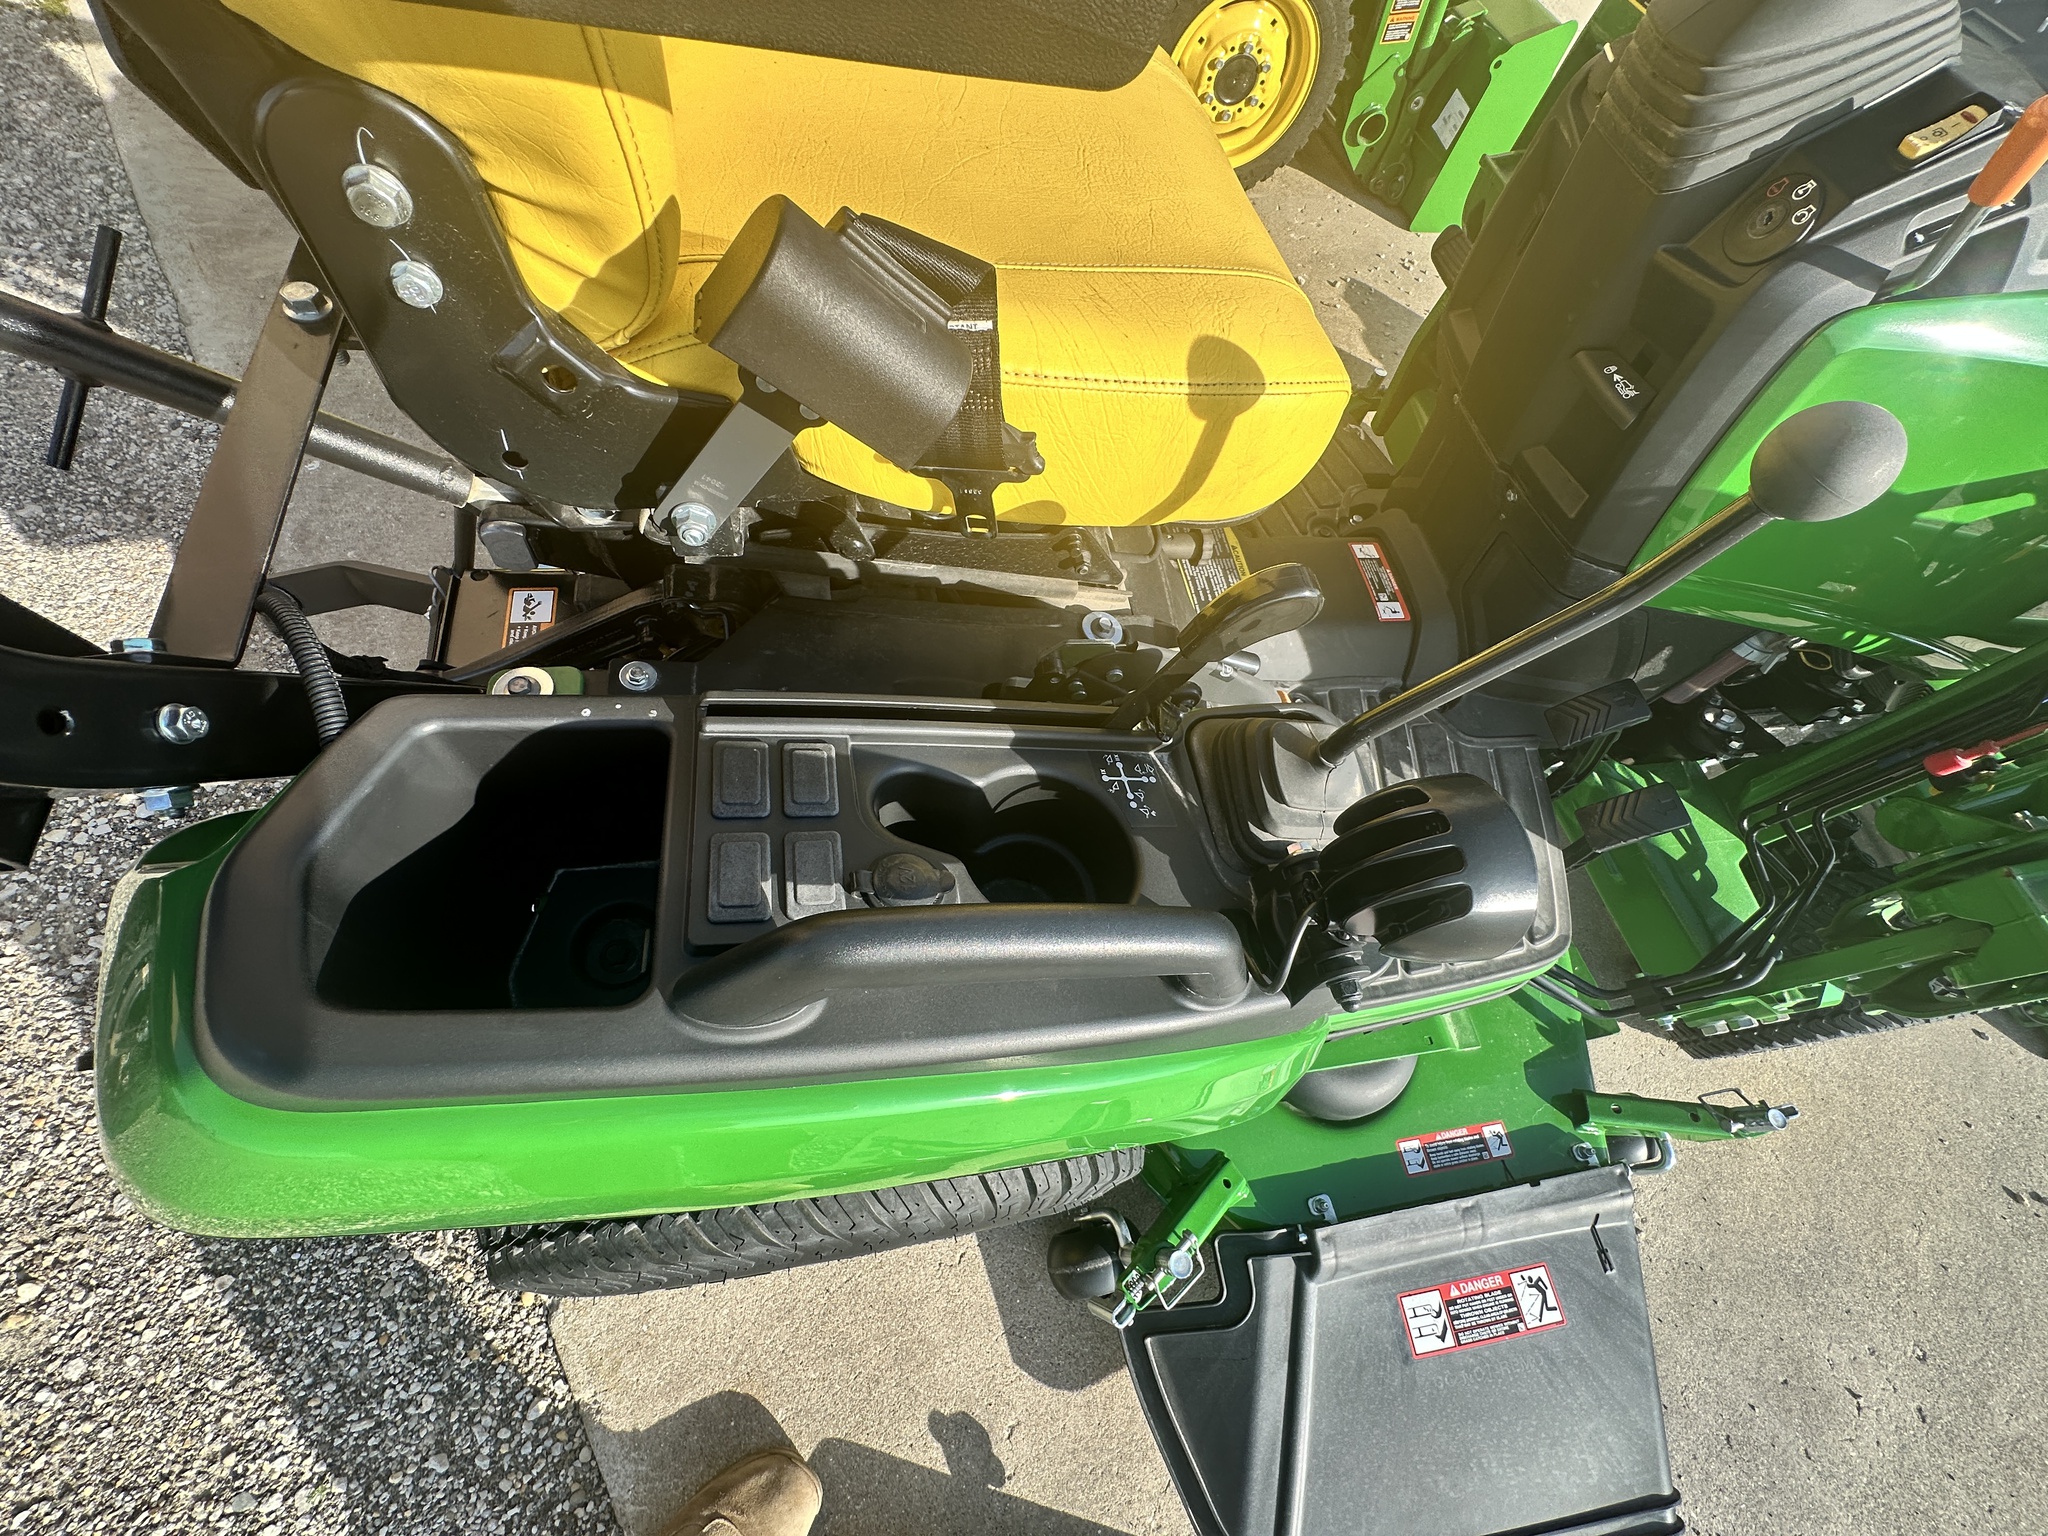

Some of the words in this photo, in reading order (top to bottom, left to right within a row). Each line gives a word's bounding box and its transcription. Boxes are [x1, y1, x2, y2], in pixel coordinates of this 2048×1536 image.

[1232, 549, 1246, 576] CAUTION
[1441, 1128, 1468, 1138] DANGER
[1459, 1275, 1503, 1294] DANGER
[1456, 1294, 1483, 1303] ROTATING
[1460, 1309, 1483, 1318] THROWN
[1484, 1304, 1508, 1312] OBJECTS
